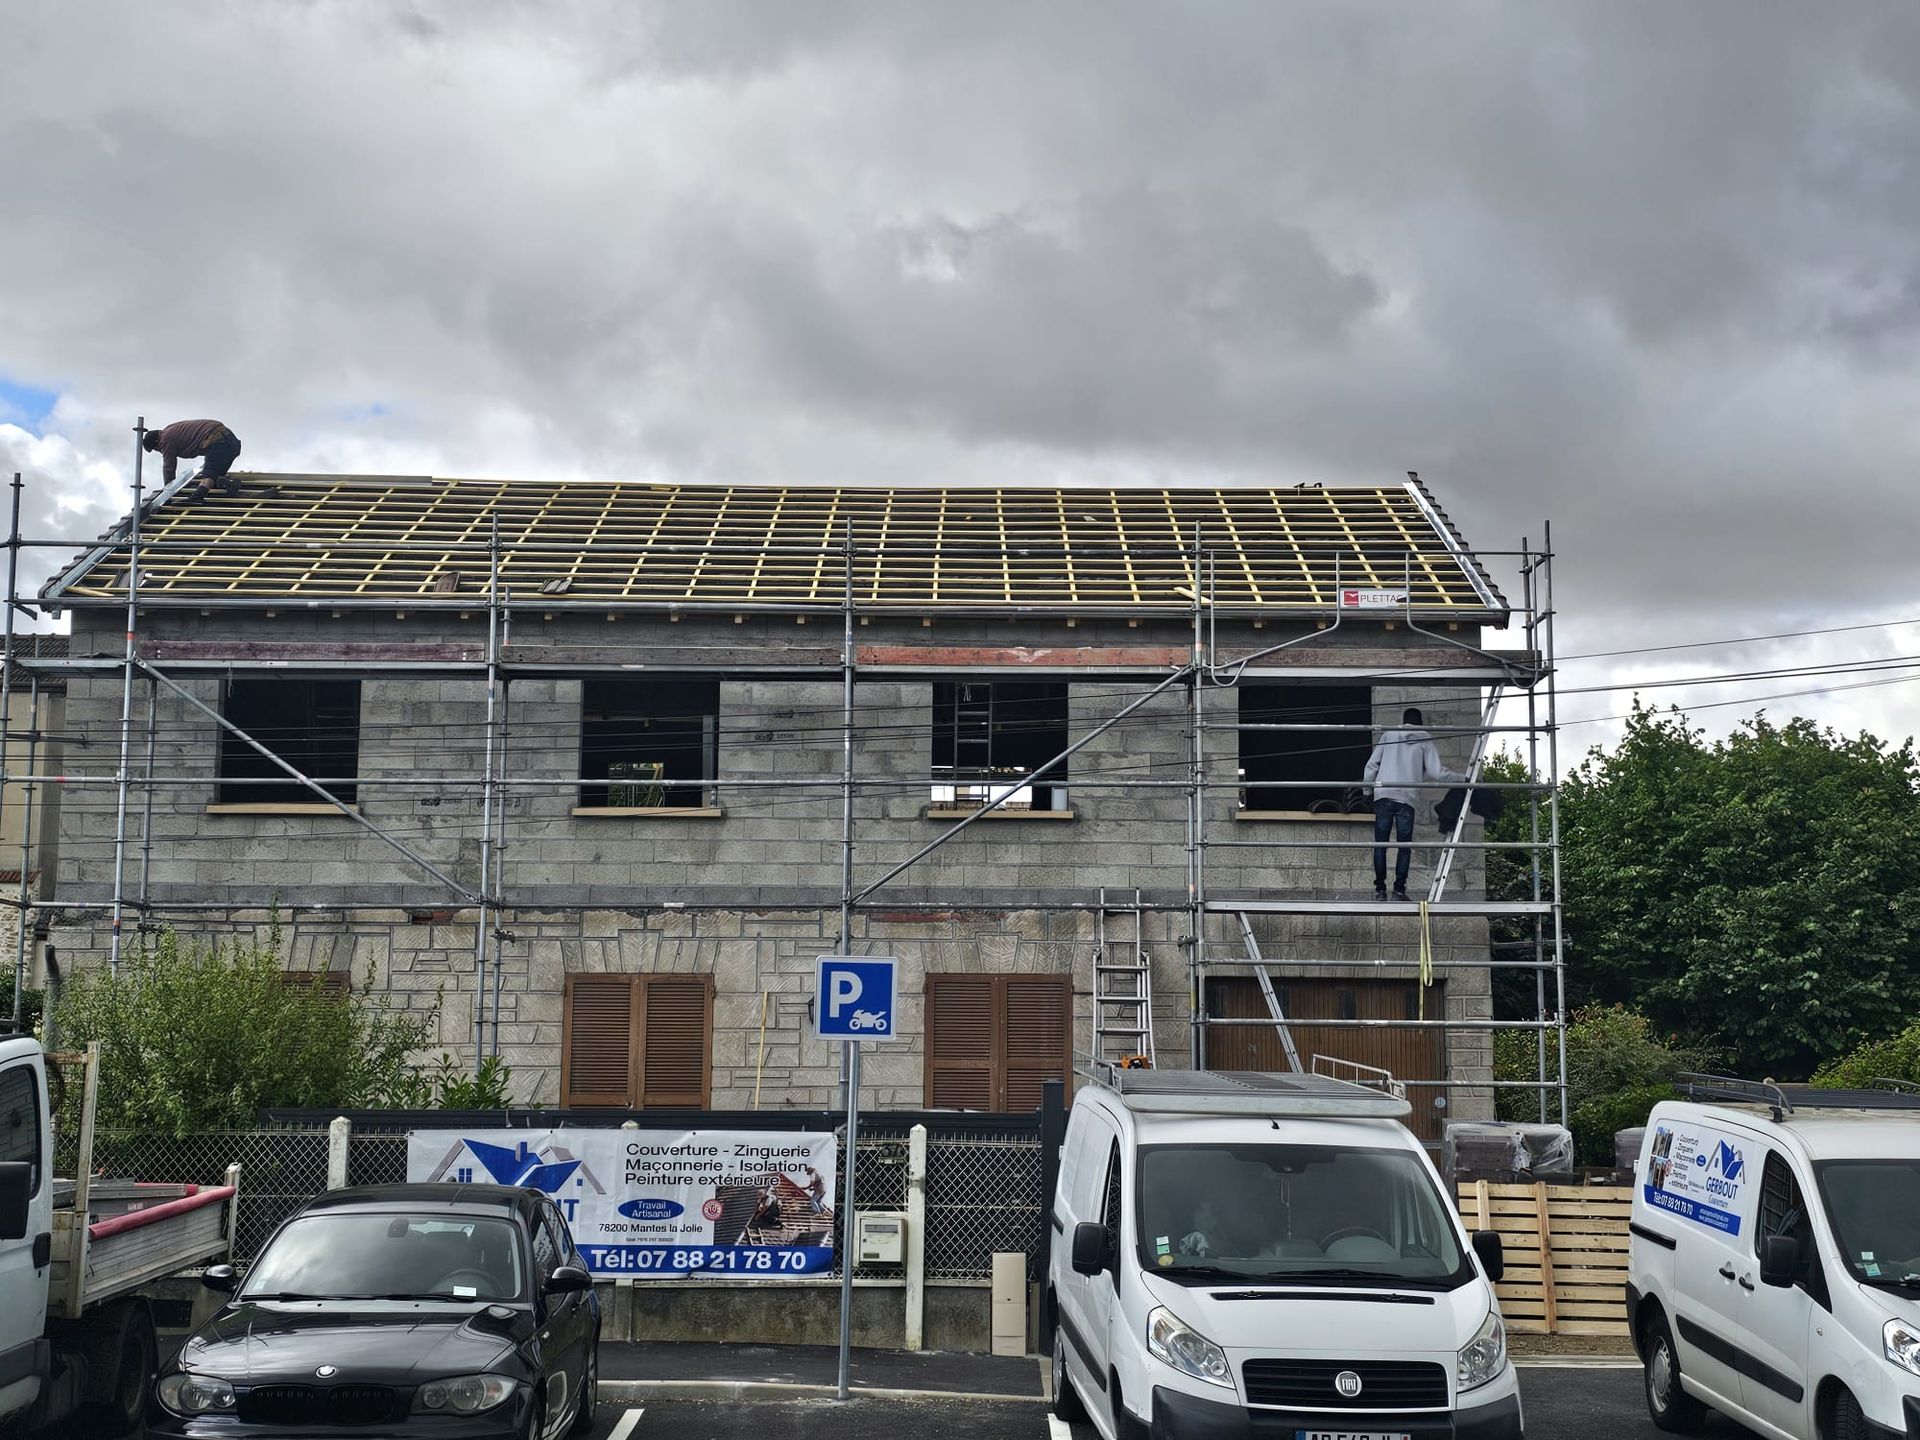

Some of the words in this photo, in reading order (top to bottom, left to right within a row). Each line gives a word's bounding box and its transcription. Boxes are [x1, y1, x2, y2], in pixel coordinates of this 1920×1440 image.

[829, 970, 863, 1018] P
[626, 1143, 718, 1156] Couverture
[734, 1144, 810, 1159] Zinguerie
[625, 1158, 723, 1173] Maçonnerie
[740, 1159, 808, 1172] Isolation
[625, 1173, 693, 1185] Peinture
[698, 1173, 780, 1186] extérieure
[1706, 1176, 1738, 1200] GERBOUT
[638, 1201, 666, 1209] Travail
[632, 1210, 671, 1218] Artisanal
[631, 1223, 667, 1233] Mantes
[669, 1223, 678, 1233] la
[680, 1223, 703, 1233] Jolie
[672, 1250, 704, 1269] 88
[710, 1251, 736, 1269] 21
[743, 1251, 772, 1269] 78
[778, 1251, 807, 1270] 70
[1341, 1378, 1356, 1391] FIAT
